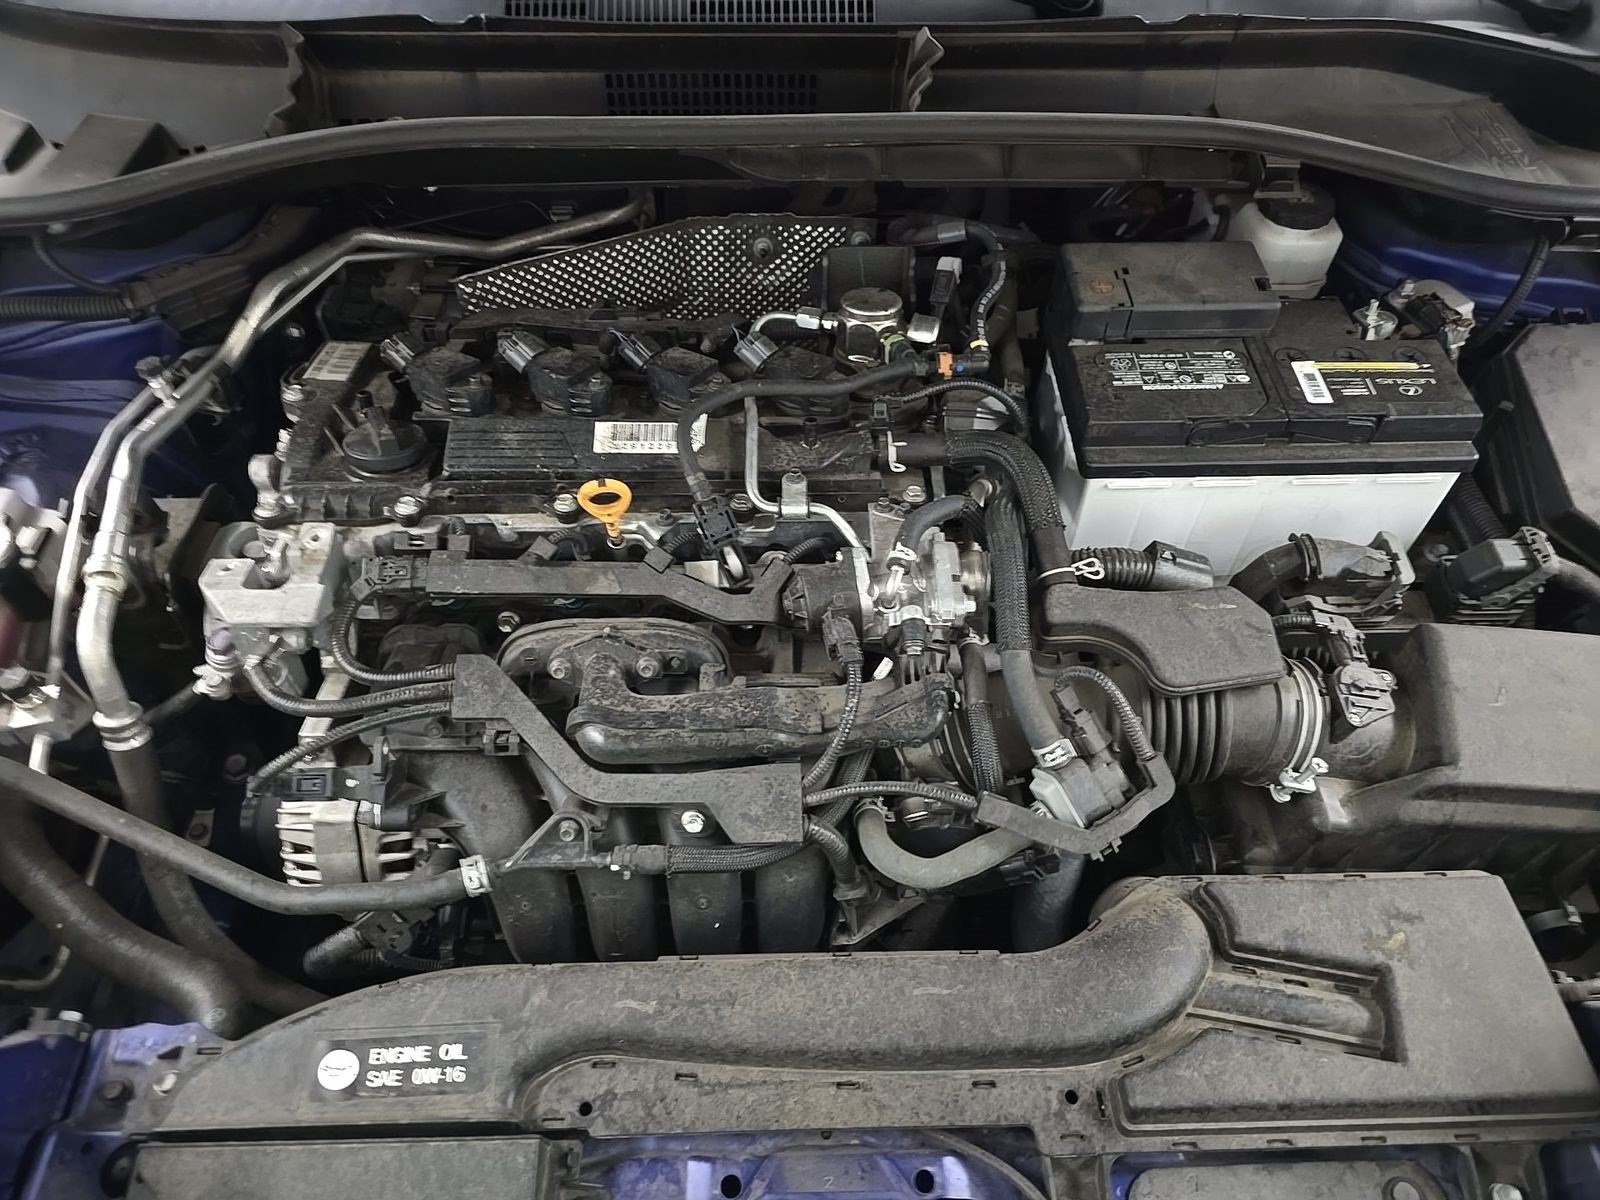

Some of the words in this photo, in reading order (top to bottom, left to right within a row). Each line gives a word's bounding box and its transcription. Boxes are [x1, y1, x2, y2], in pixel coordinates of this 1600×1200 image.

[1375, 377, 1437, 385] LEXUS
[368, 1045, 433, 1065] ENGINE
[438, 1043, 469, 1061] OIL
[365, 1069, 404, 1088] SAE
[411, 1065, 467, 1085] 0W-16
